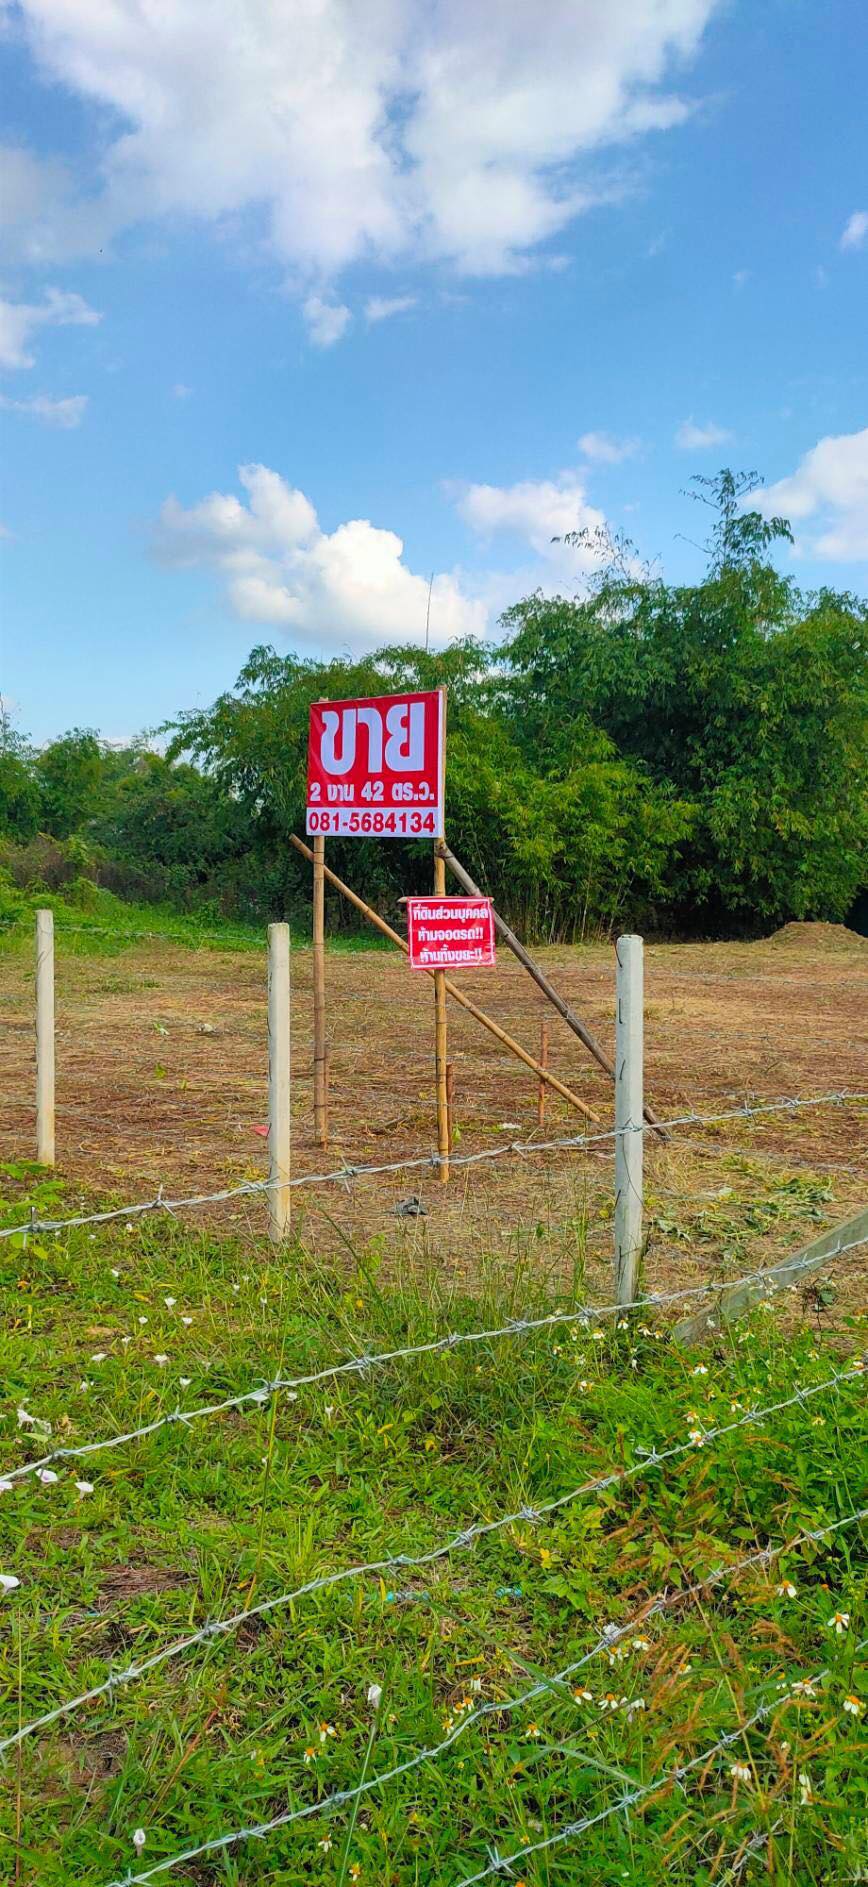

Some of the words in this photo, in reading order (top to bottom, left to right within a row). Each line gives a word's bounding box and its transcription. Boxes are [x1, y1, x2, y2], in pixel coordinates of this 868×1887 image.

[320, 702, 426, 776] ขาย
[310, 782, 321, 802] 2
[327, 784, 355, 802] งาน
[361, 781, 384, 801] 42
[391, 781, 435, 801] ตร.ว.
[309, 811, 436, 833] 081-5684134
[413, 903, 489, 923] ที่ดินส่วนบุคคล
